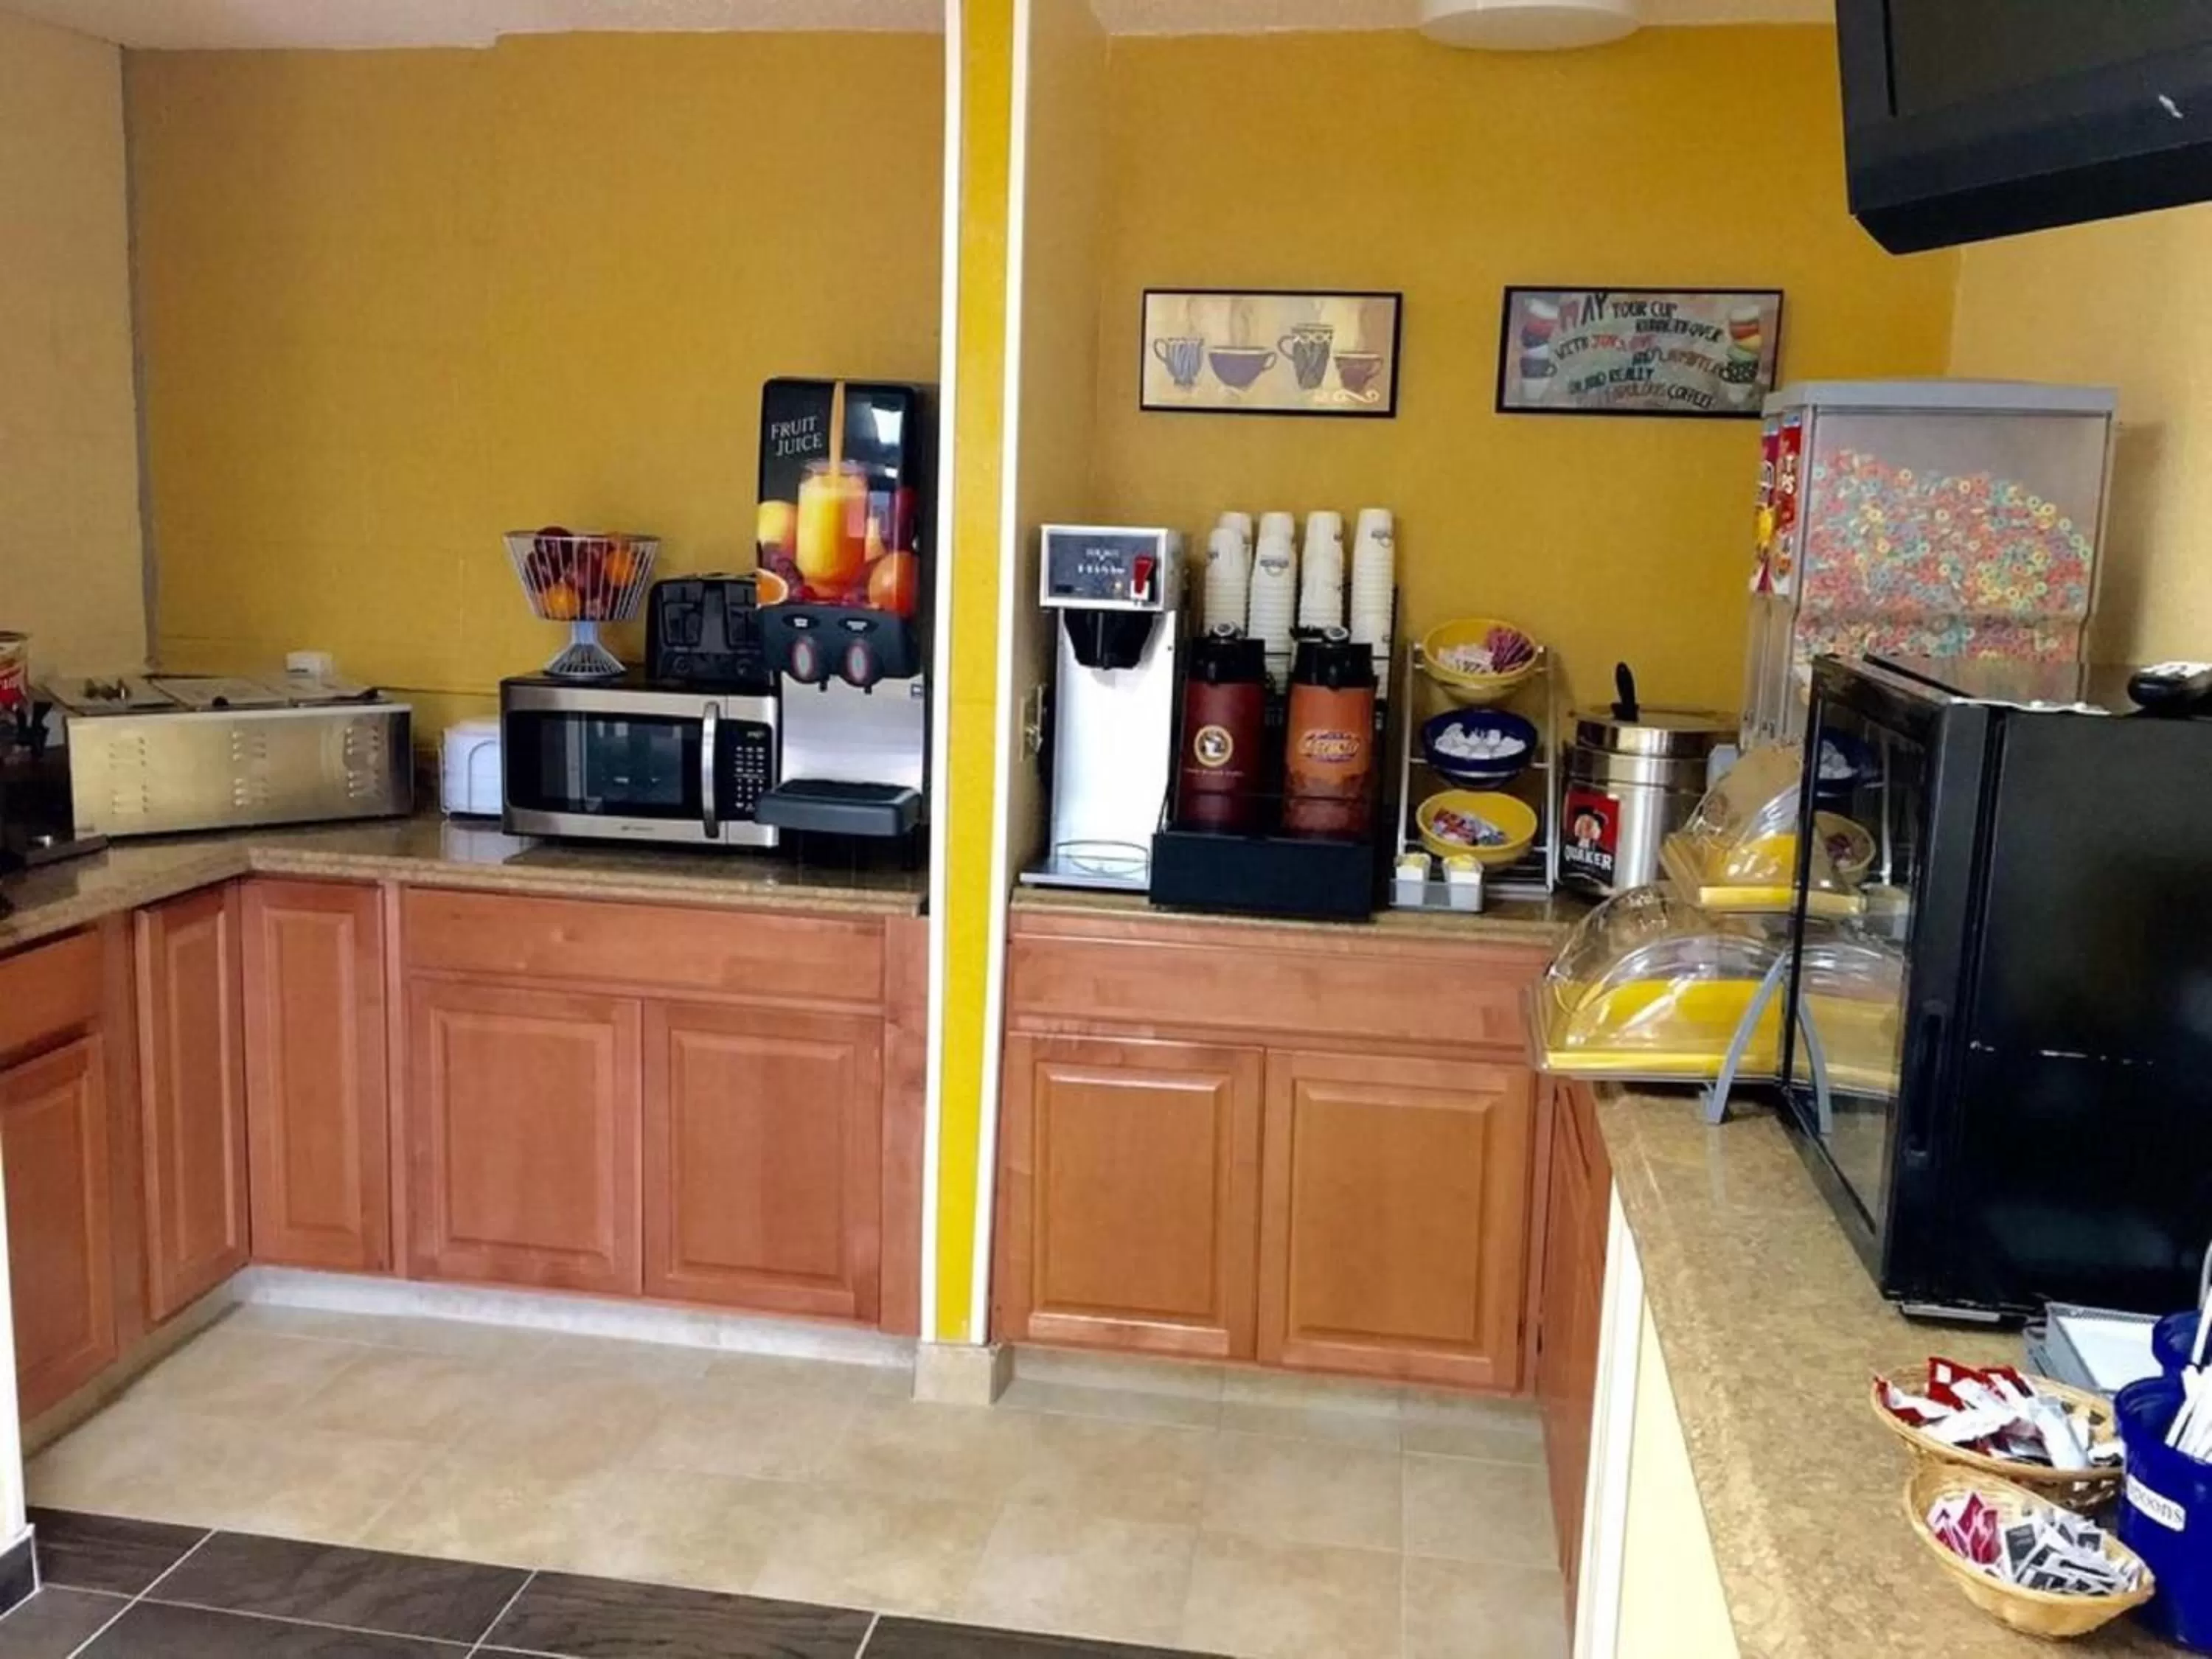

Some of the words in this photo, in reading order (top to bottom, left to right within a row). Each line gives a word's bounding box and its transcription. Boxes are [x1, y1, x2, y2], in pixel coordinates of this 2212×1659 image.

[771, 416, 817, 441] FRUIT
[775, 432, 823, 456] JUICE
[1564, 845, 1612, 871] QUAKER
